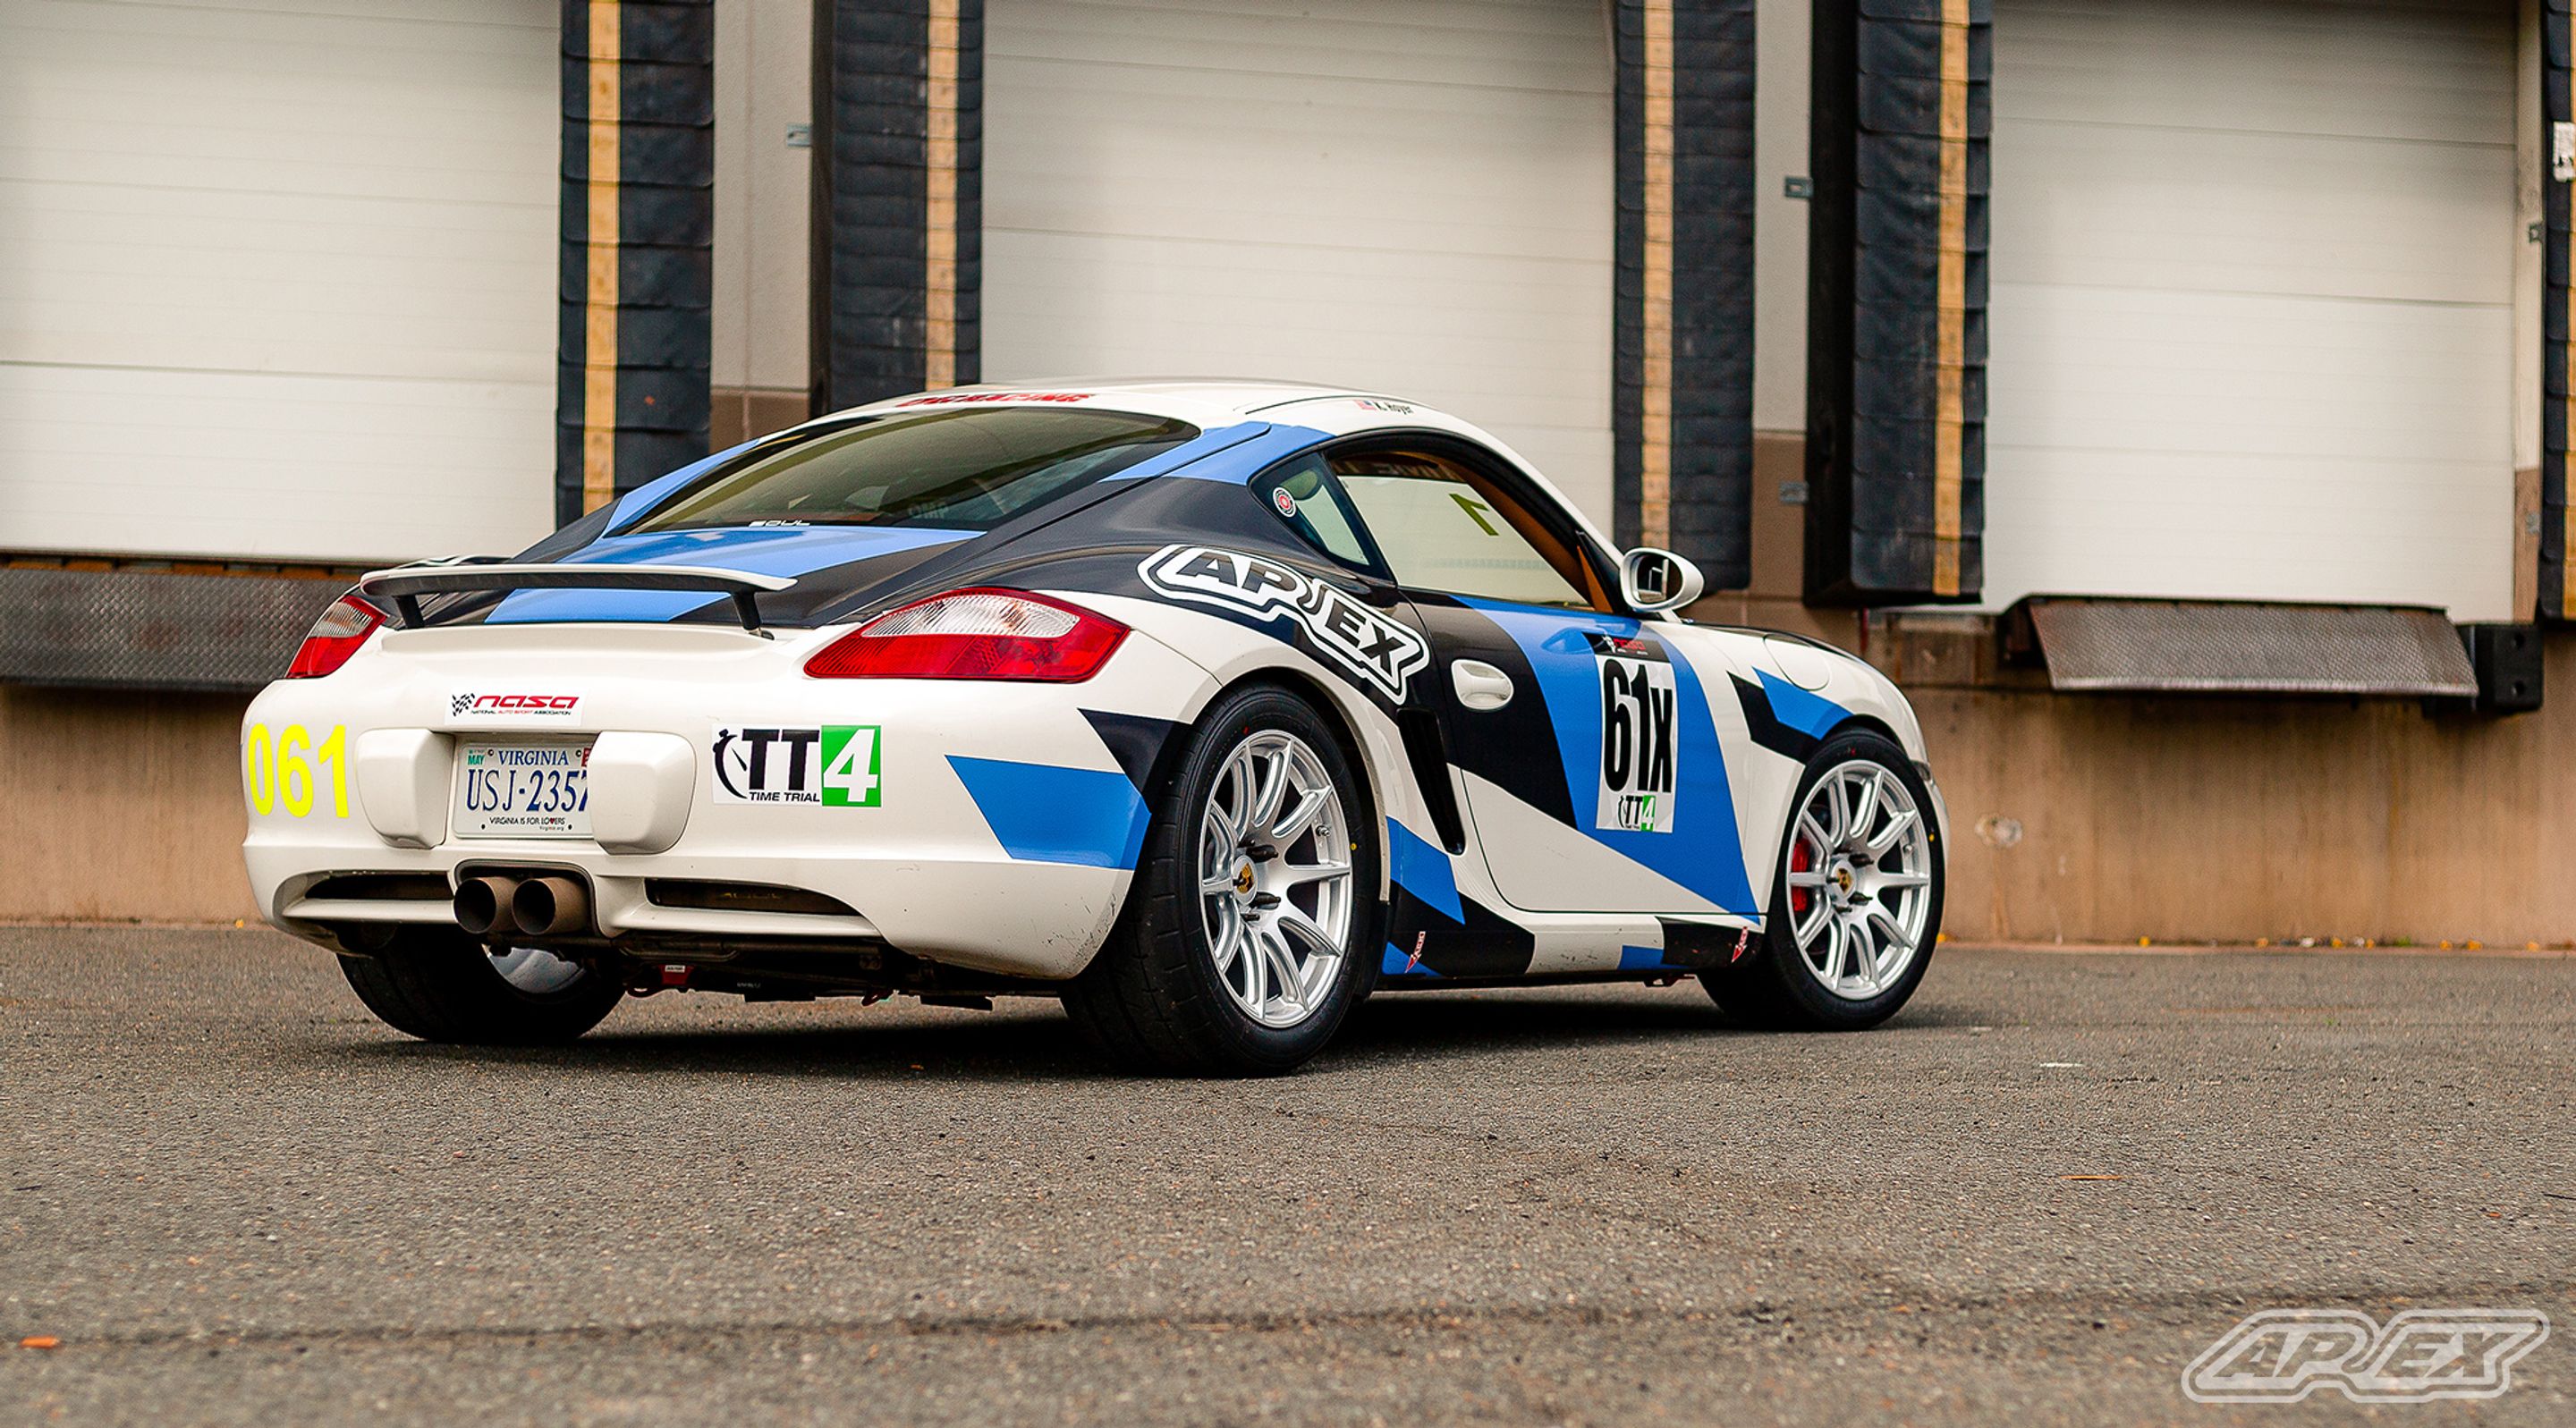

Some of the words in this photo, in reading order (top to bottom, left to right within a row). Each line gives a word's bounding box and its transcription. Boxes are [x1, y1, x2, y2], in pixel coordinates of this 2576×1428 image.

[1156, 547, 1419, 689] APEX
[467, 755, 485, 765] MAY
[499, 750, 570, 766] VIRGINIA
[248, 722, 350, 818] 061
[749, 791, 781, 801] TIME
[784, 792, 820, 803] TRIAL
[489, 816, 519, 825] VIRGINIA
[526, 816, 540, 825] FOR
